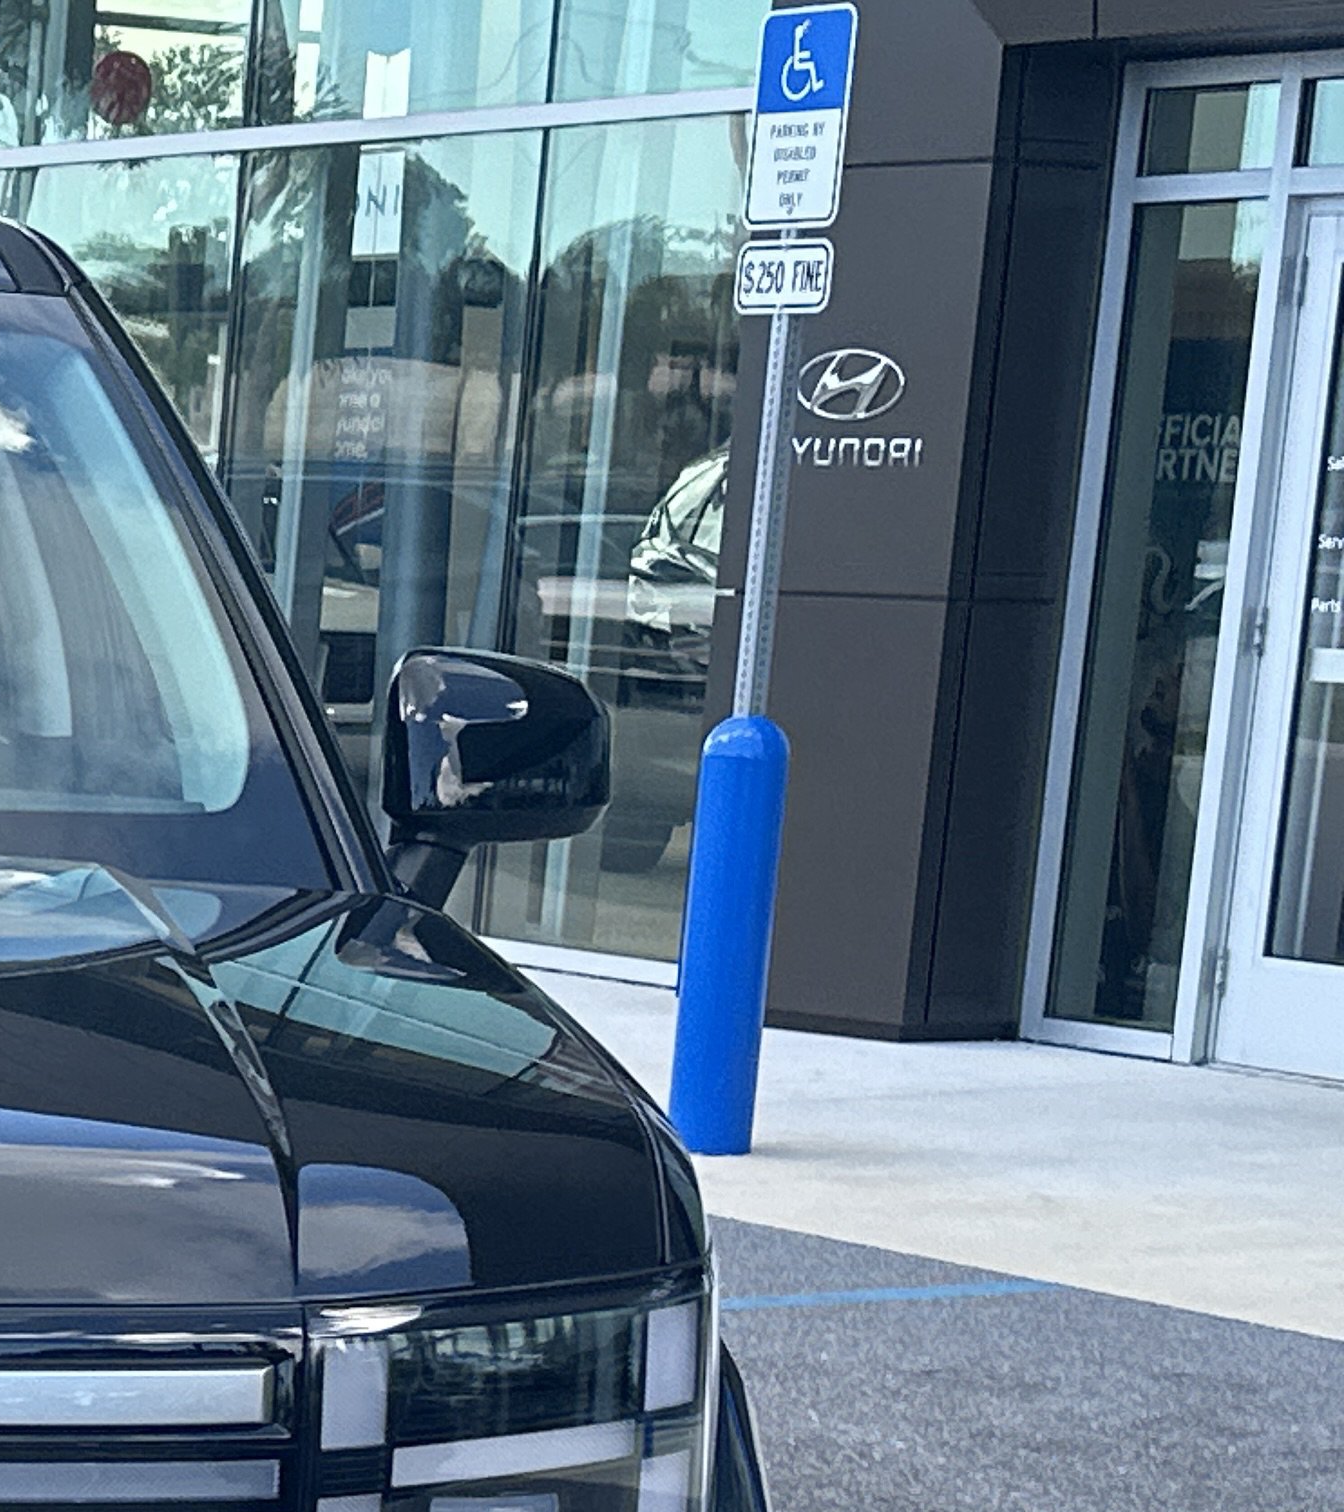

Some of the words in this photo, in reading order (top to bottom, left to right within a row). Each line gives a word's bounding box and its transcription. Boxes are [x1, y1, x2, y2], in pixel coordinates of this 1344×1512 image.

[743, 260, 785, 297] $250
[792, 260, 824, 293] FINE
[1162, 412, 1242, 447] FICIA
[791, 437, 923, 467] YUNDAI
[1155, 448, 1239, 482] RTNE
[1311, 597, 1341, 613] Parts
